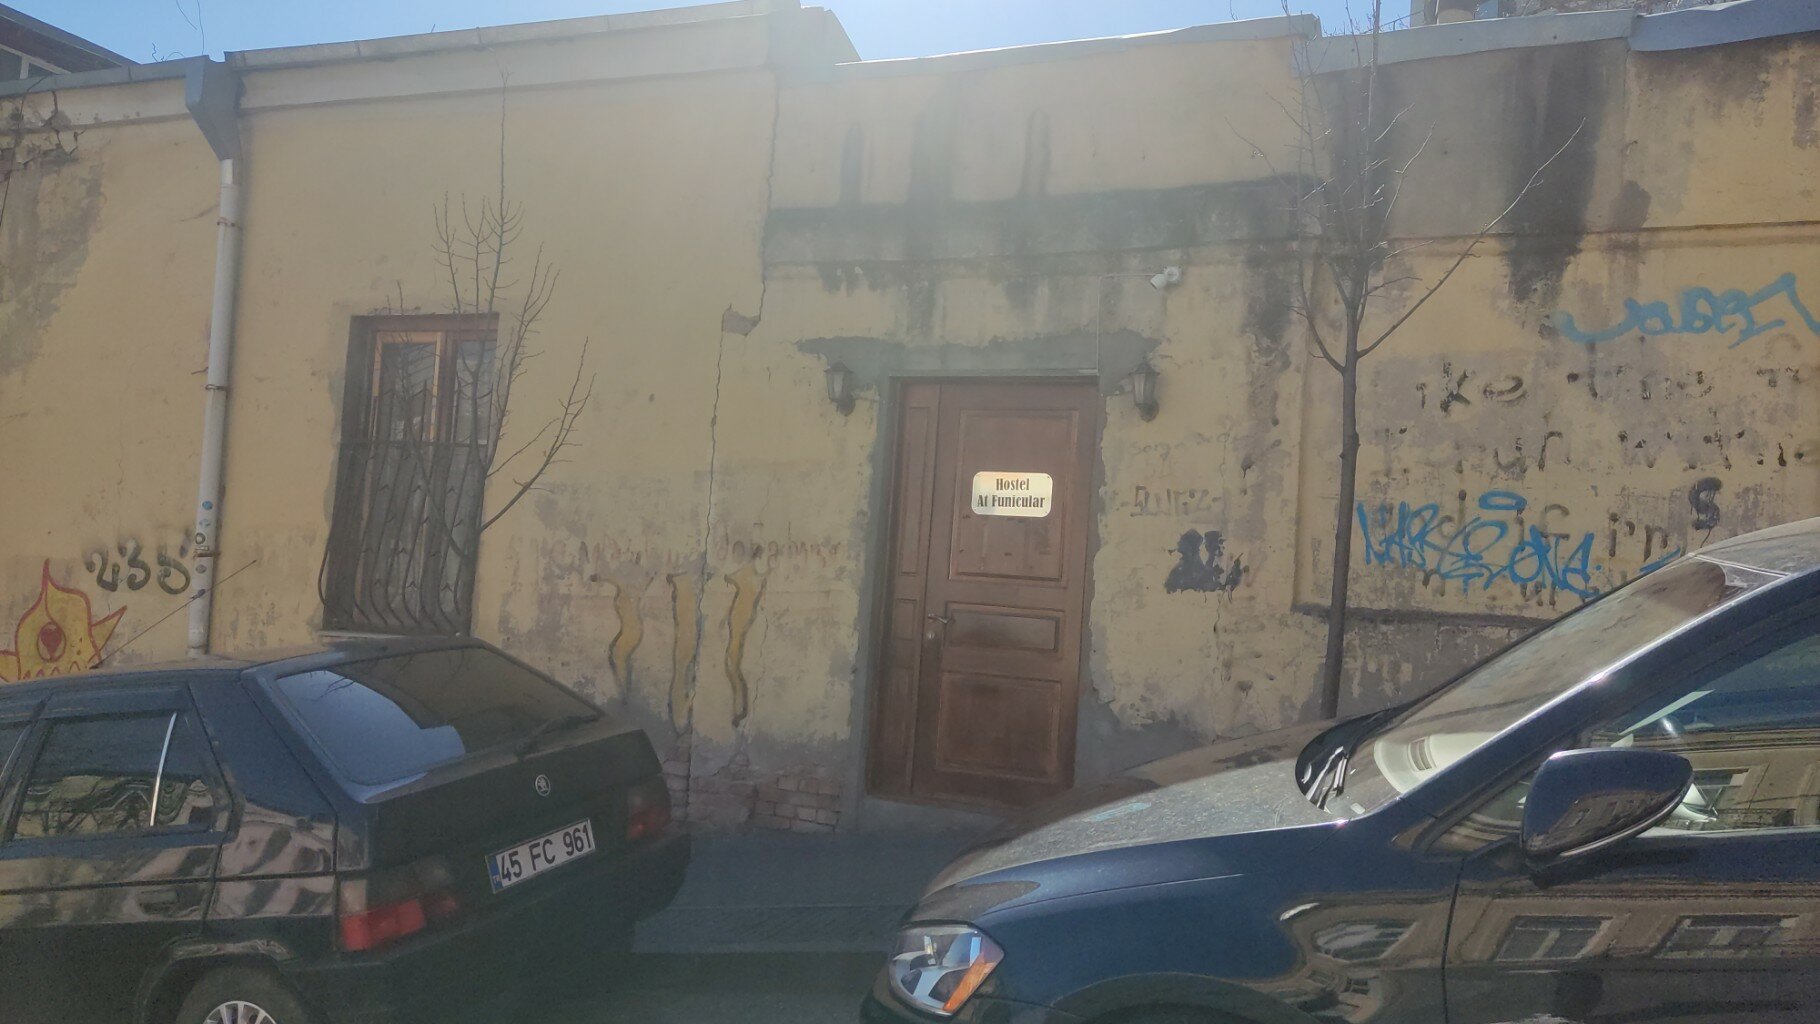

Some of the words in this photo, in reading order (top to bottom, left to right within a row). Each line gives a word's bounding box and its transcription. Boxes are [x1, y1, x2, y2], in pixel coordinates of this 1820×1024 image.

[996, 478, 1030, 490] Hostel
[977, 495, 989, 507] At
[992, 495, 1046, 508] Funicular
[501, 850, 522, 882] 45
[528, 838, 556, 871] FC
[562, 824, 592, 856] 961
